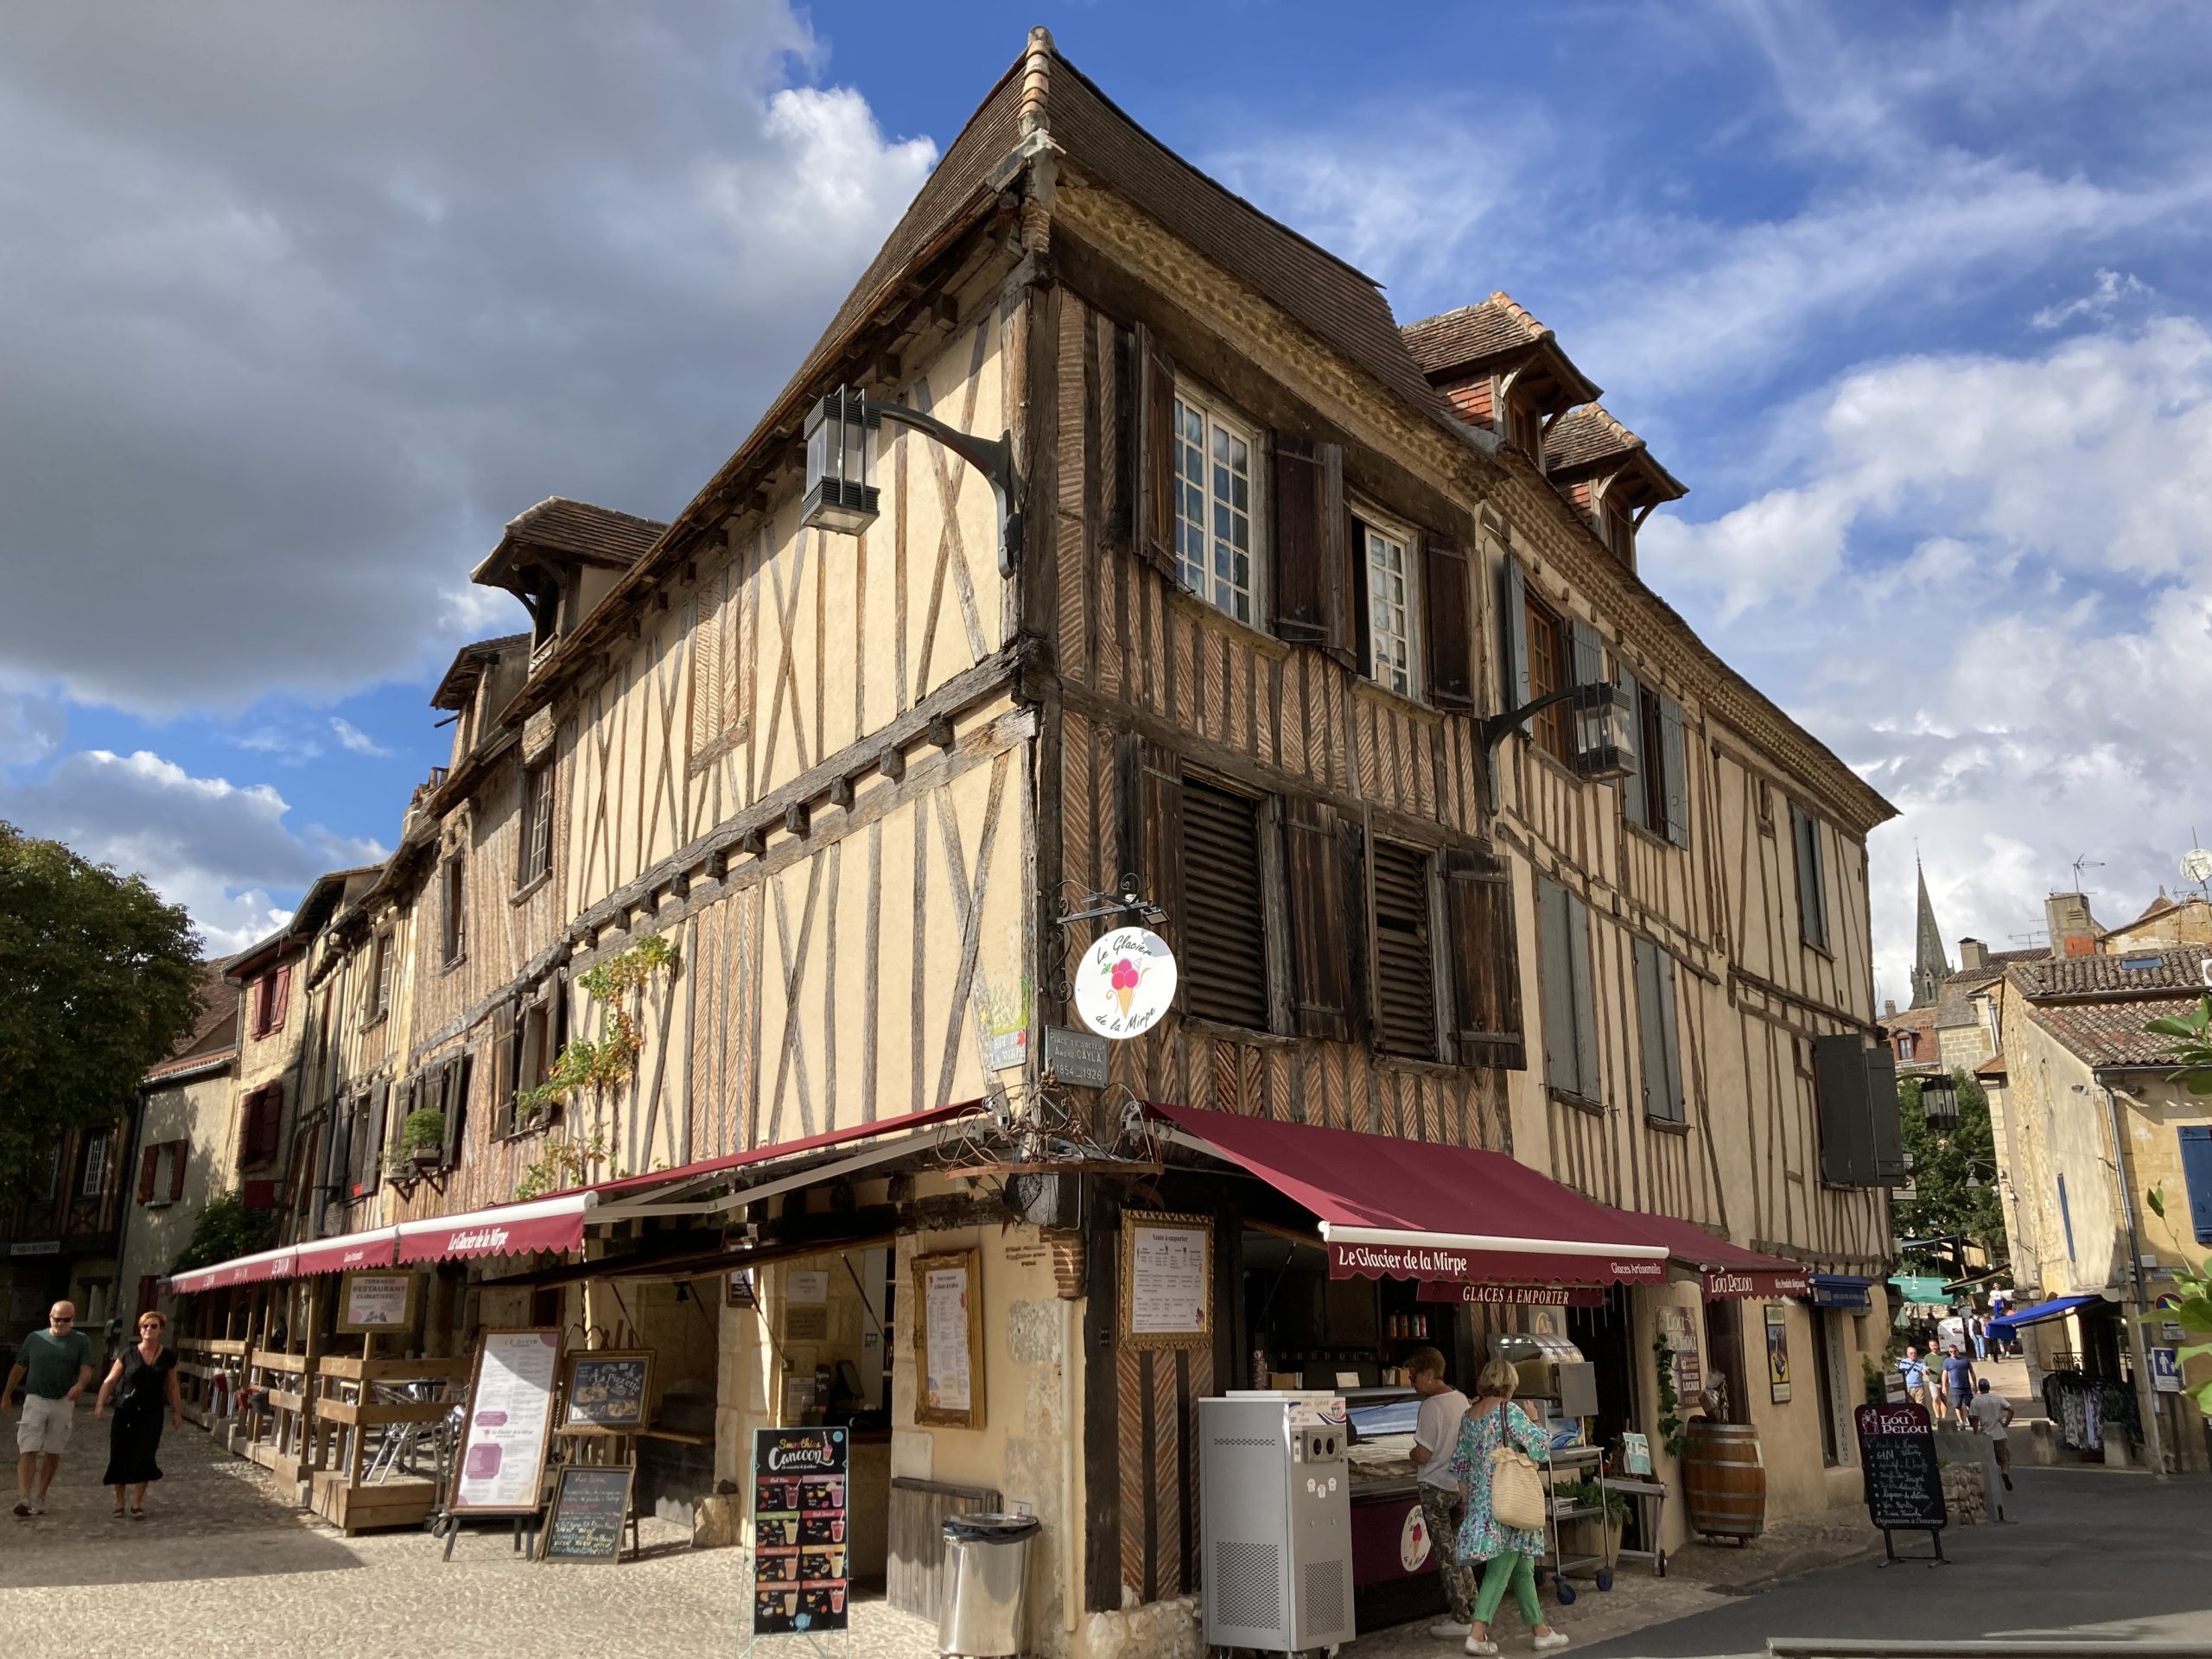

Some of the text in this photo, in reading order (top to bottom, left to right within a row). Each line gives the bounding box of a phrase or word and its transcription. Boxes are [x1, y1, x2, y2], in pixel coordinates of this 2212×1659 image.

[1096, 934, 1153, 964] Le Glacier
[1095, 1007, 1155, 1033] de la Mirpe
[1076, 1049, 1102, 1064] CAYLA
[1338, 1246, 1467, 1275] Le Glacier de la Mirpe
[1611, 1262, 1631, 1274] Glaces
[1462, 1286, 1570, 1306] GLACES A EMPORTER
[778, 1437, 822, 1450] Smoothies
[1877, 1449, 1894, 1459] GIN
